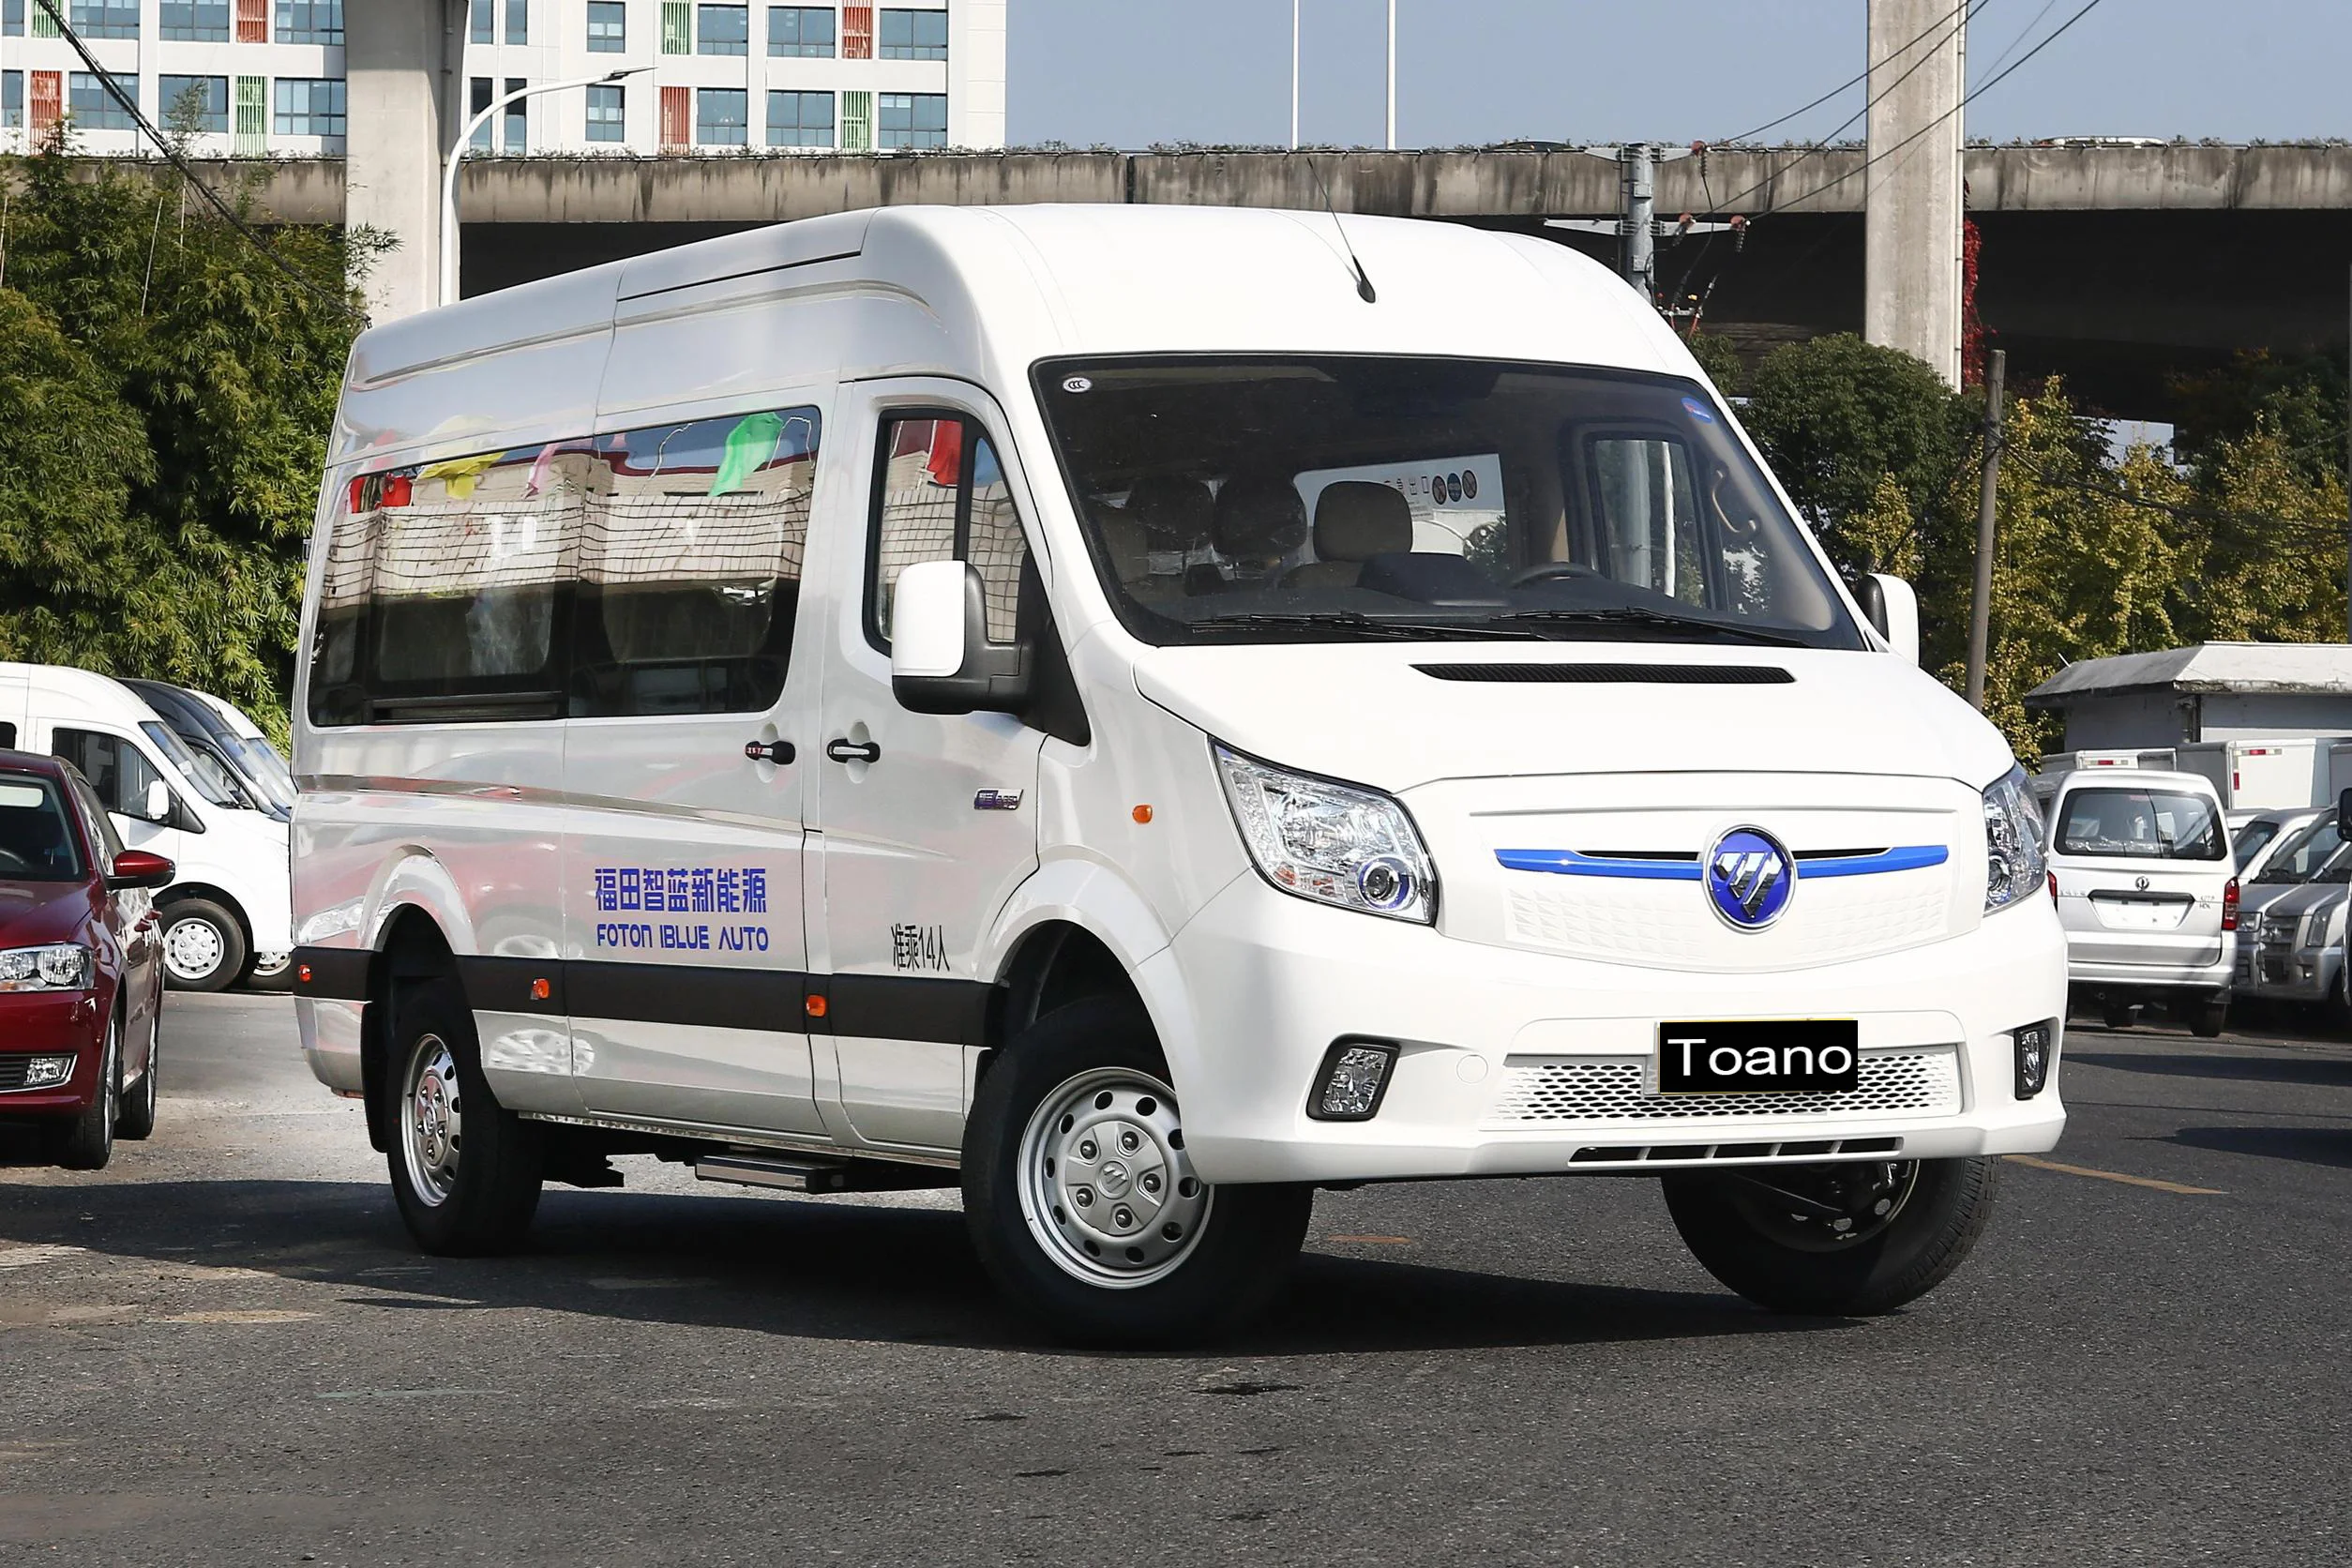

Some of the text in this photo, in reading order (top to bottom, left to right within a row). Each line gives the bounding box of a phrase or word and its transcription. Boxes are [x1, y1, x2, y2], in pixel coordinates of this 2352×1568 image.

[595, 867, 766, 912] 福田智蓝新能源
[718, 926, 768, 951] AUTO
[891, 923, 950, 972] 准乘14人
